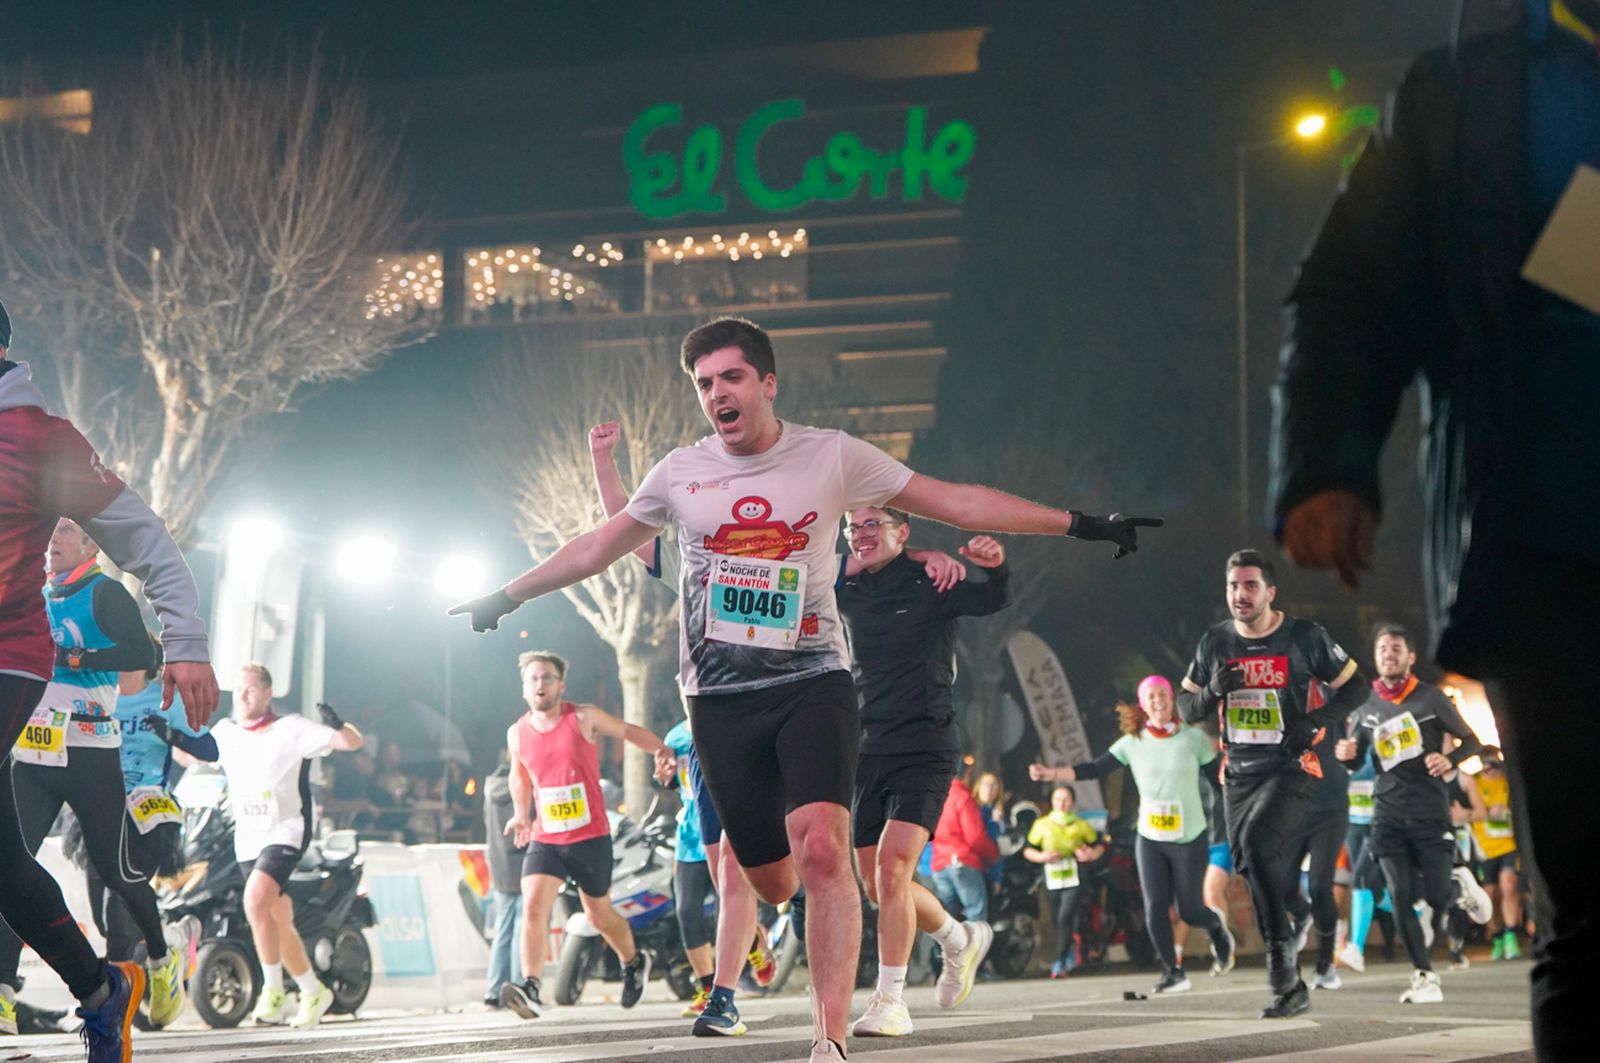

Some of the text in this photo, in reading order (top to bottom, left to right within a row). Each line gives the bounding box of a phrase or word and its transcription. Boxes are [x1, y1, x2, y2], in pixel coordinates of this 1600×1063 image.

[624, 98, 976, 219] El Corte
[729, 565, 758, 577] NOCHE
[759, 568, 771, 579] DE
[718, 574, 737, 586] SAN
[737, 576, 770, 590] ANTÓN
[723, 586, 787, 619] 9046
[1238, 659, 1275, 674] NTRE
[1237, 708, 1271, 725] 4219
[25, 725, 52, 746] 460
[550, 802, 577, 817] 6751
